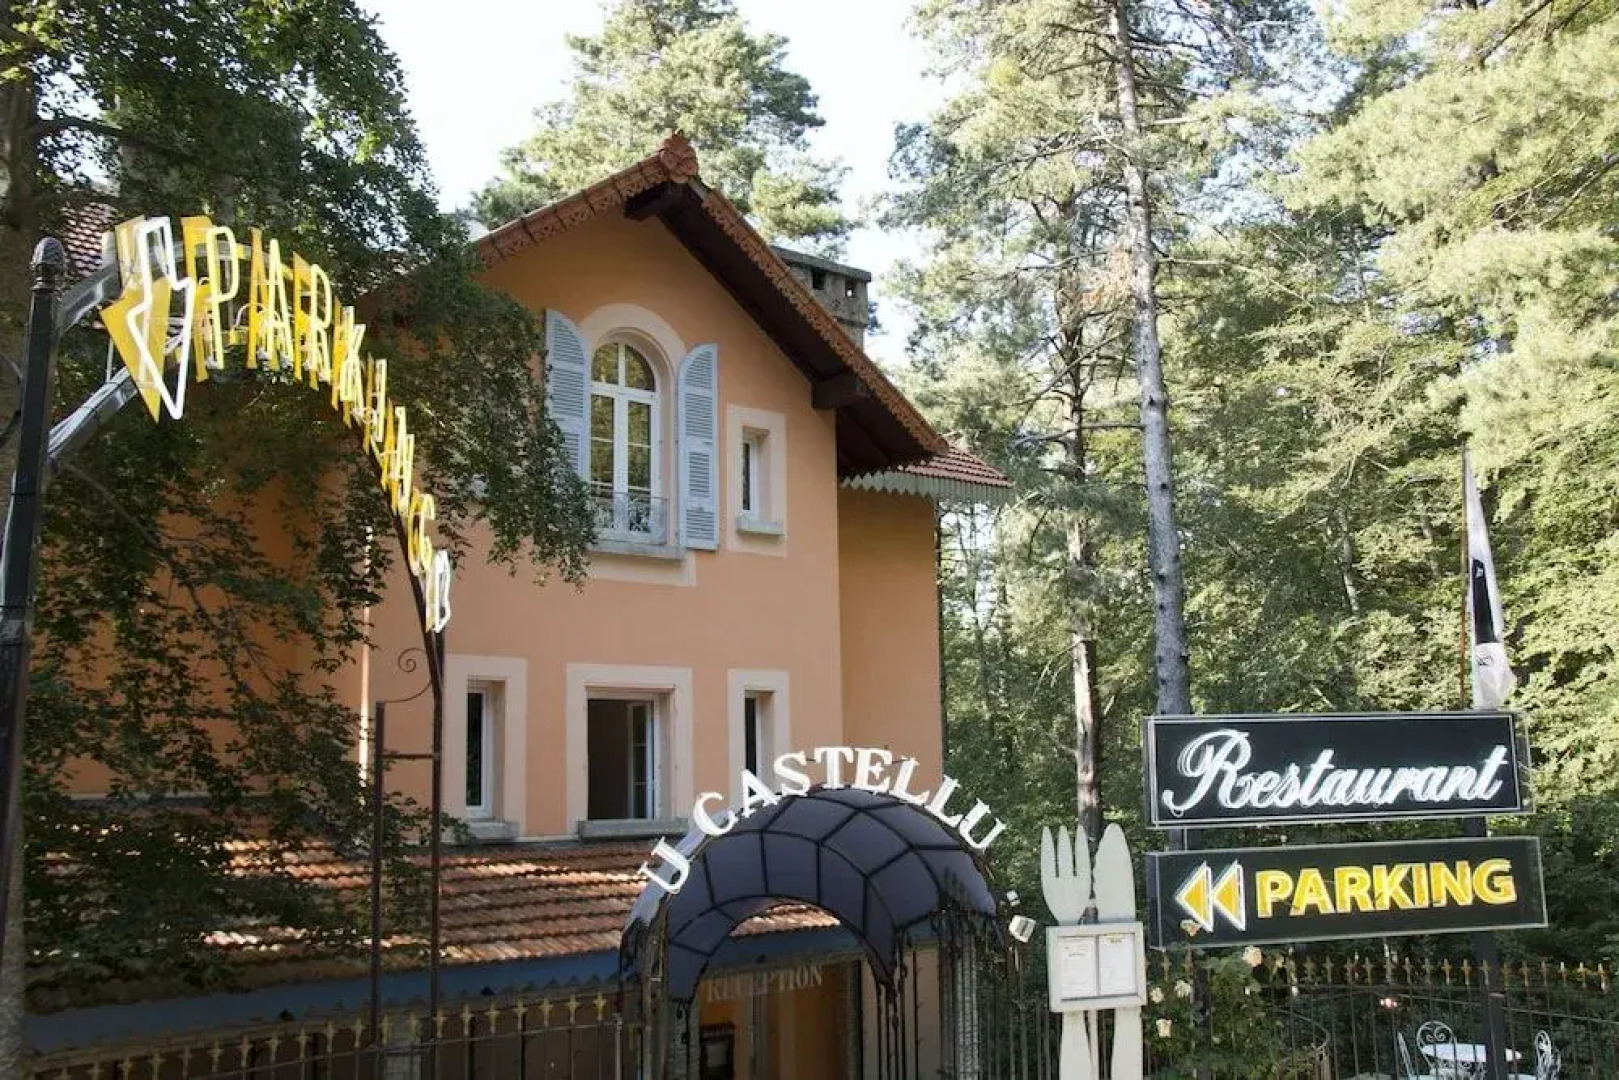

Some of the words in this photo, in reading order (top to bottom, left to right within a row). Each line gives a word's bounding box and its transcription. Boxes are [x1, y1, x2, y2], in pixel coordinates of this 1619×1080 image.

[1162, 729, 1508, 816] Restaurant
[639, 836, 690, 894] U
[693, 747, 1006, 850] CASTELLU
[1255, 859, 1517, 918] PARKING
